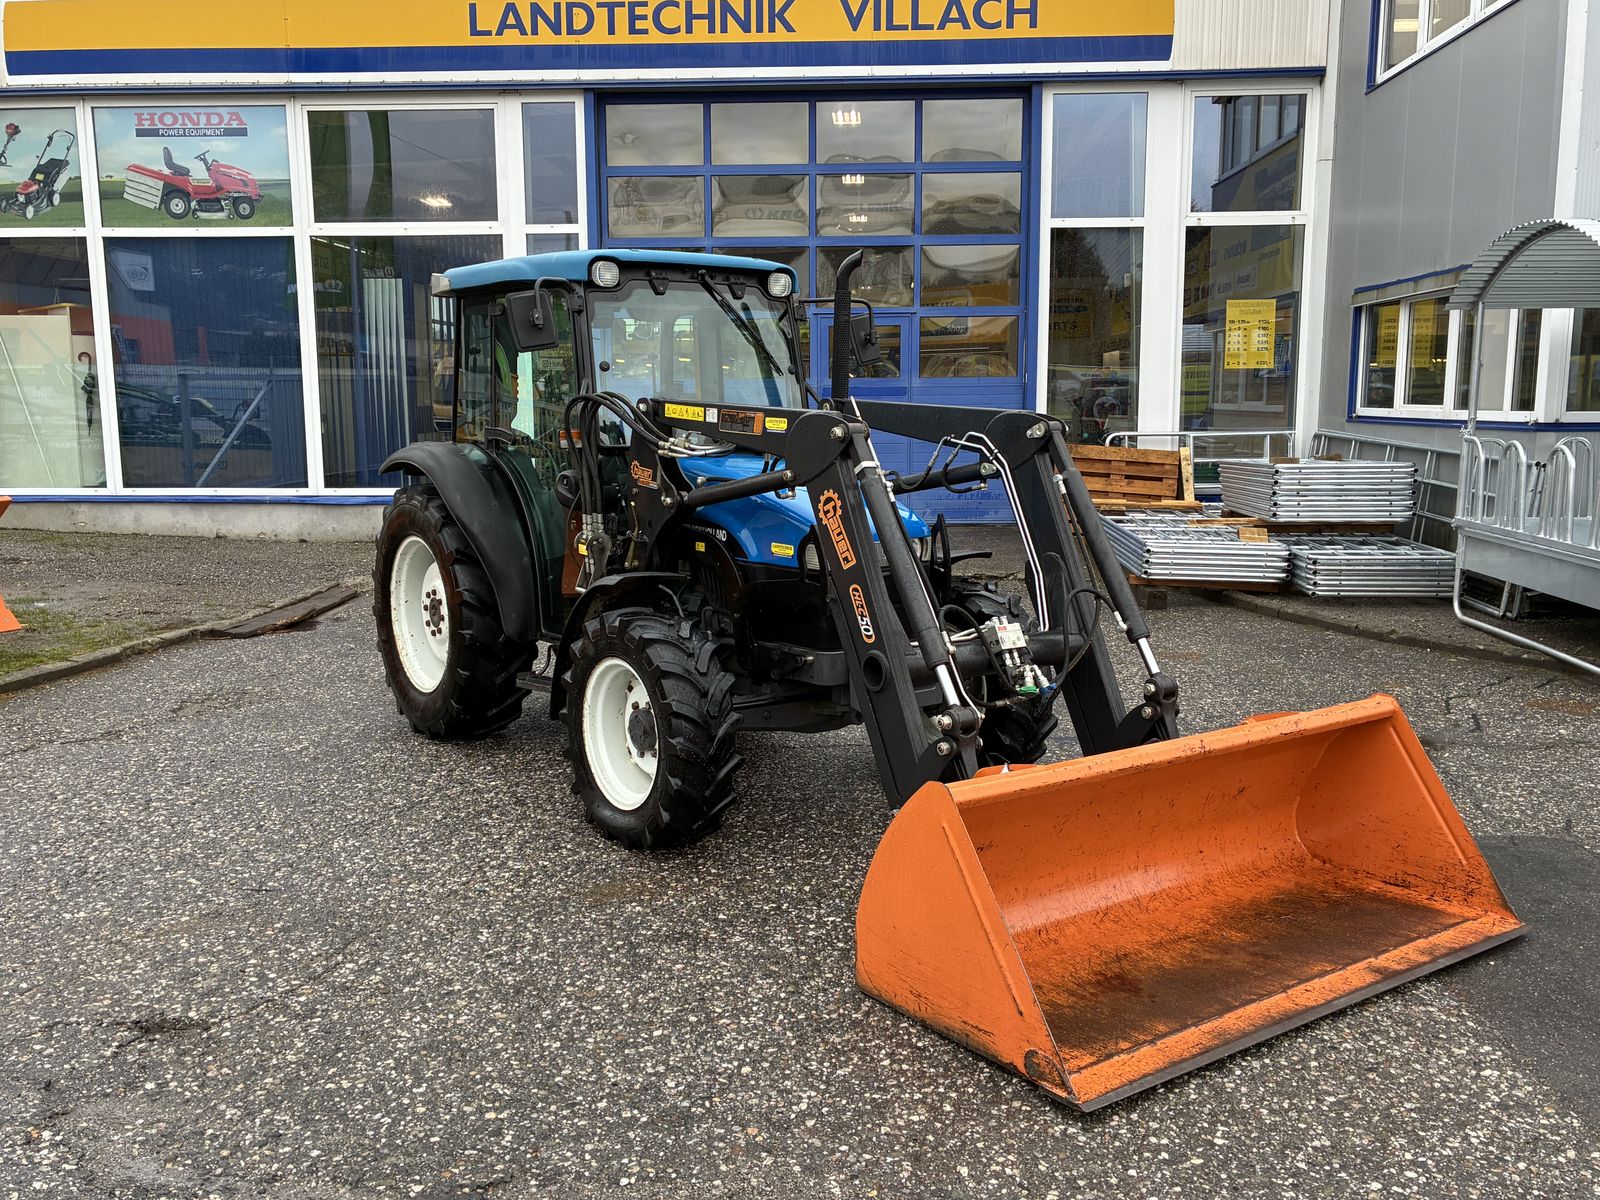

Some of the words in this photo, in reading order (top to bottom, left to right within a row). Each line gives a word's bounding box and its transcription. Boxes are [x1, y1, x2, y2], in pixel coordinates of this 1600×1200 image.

[468, 0, 798, 36] LANDTECHNIK
[839, 0, 1038, 32] VILLACH
[134, 111, 248, 127] HONDA
[186, 128, 225, 136] EQUIPMENT
[822, 499, 854, 567] hauer
